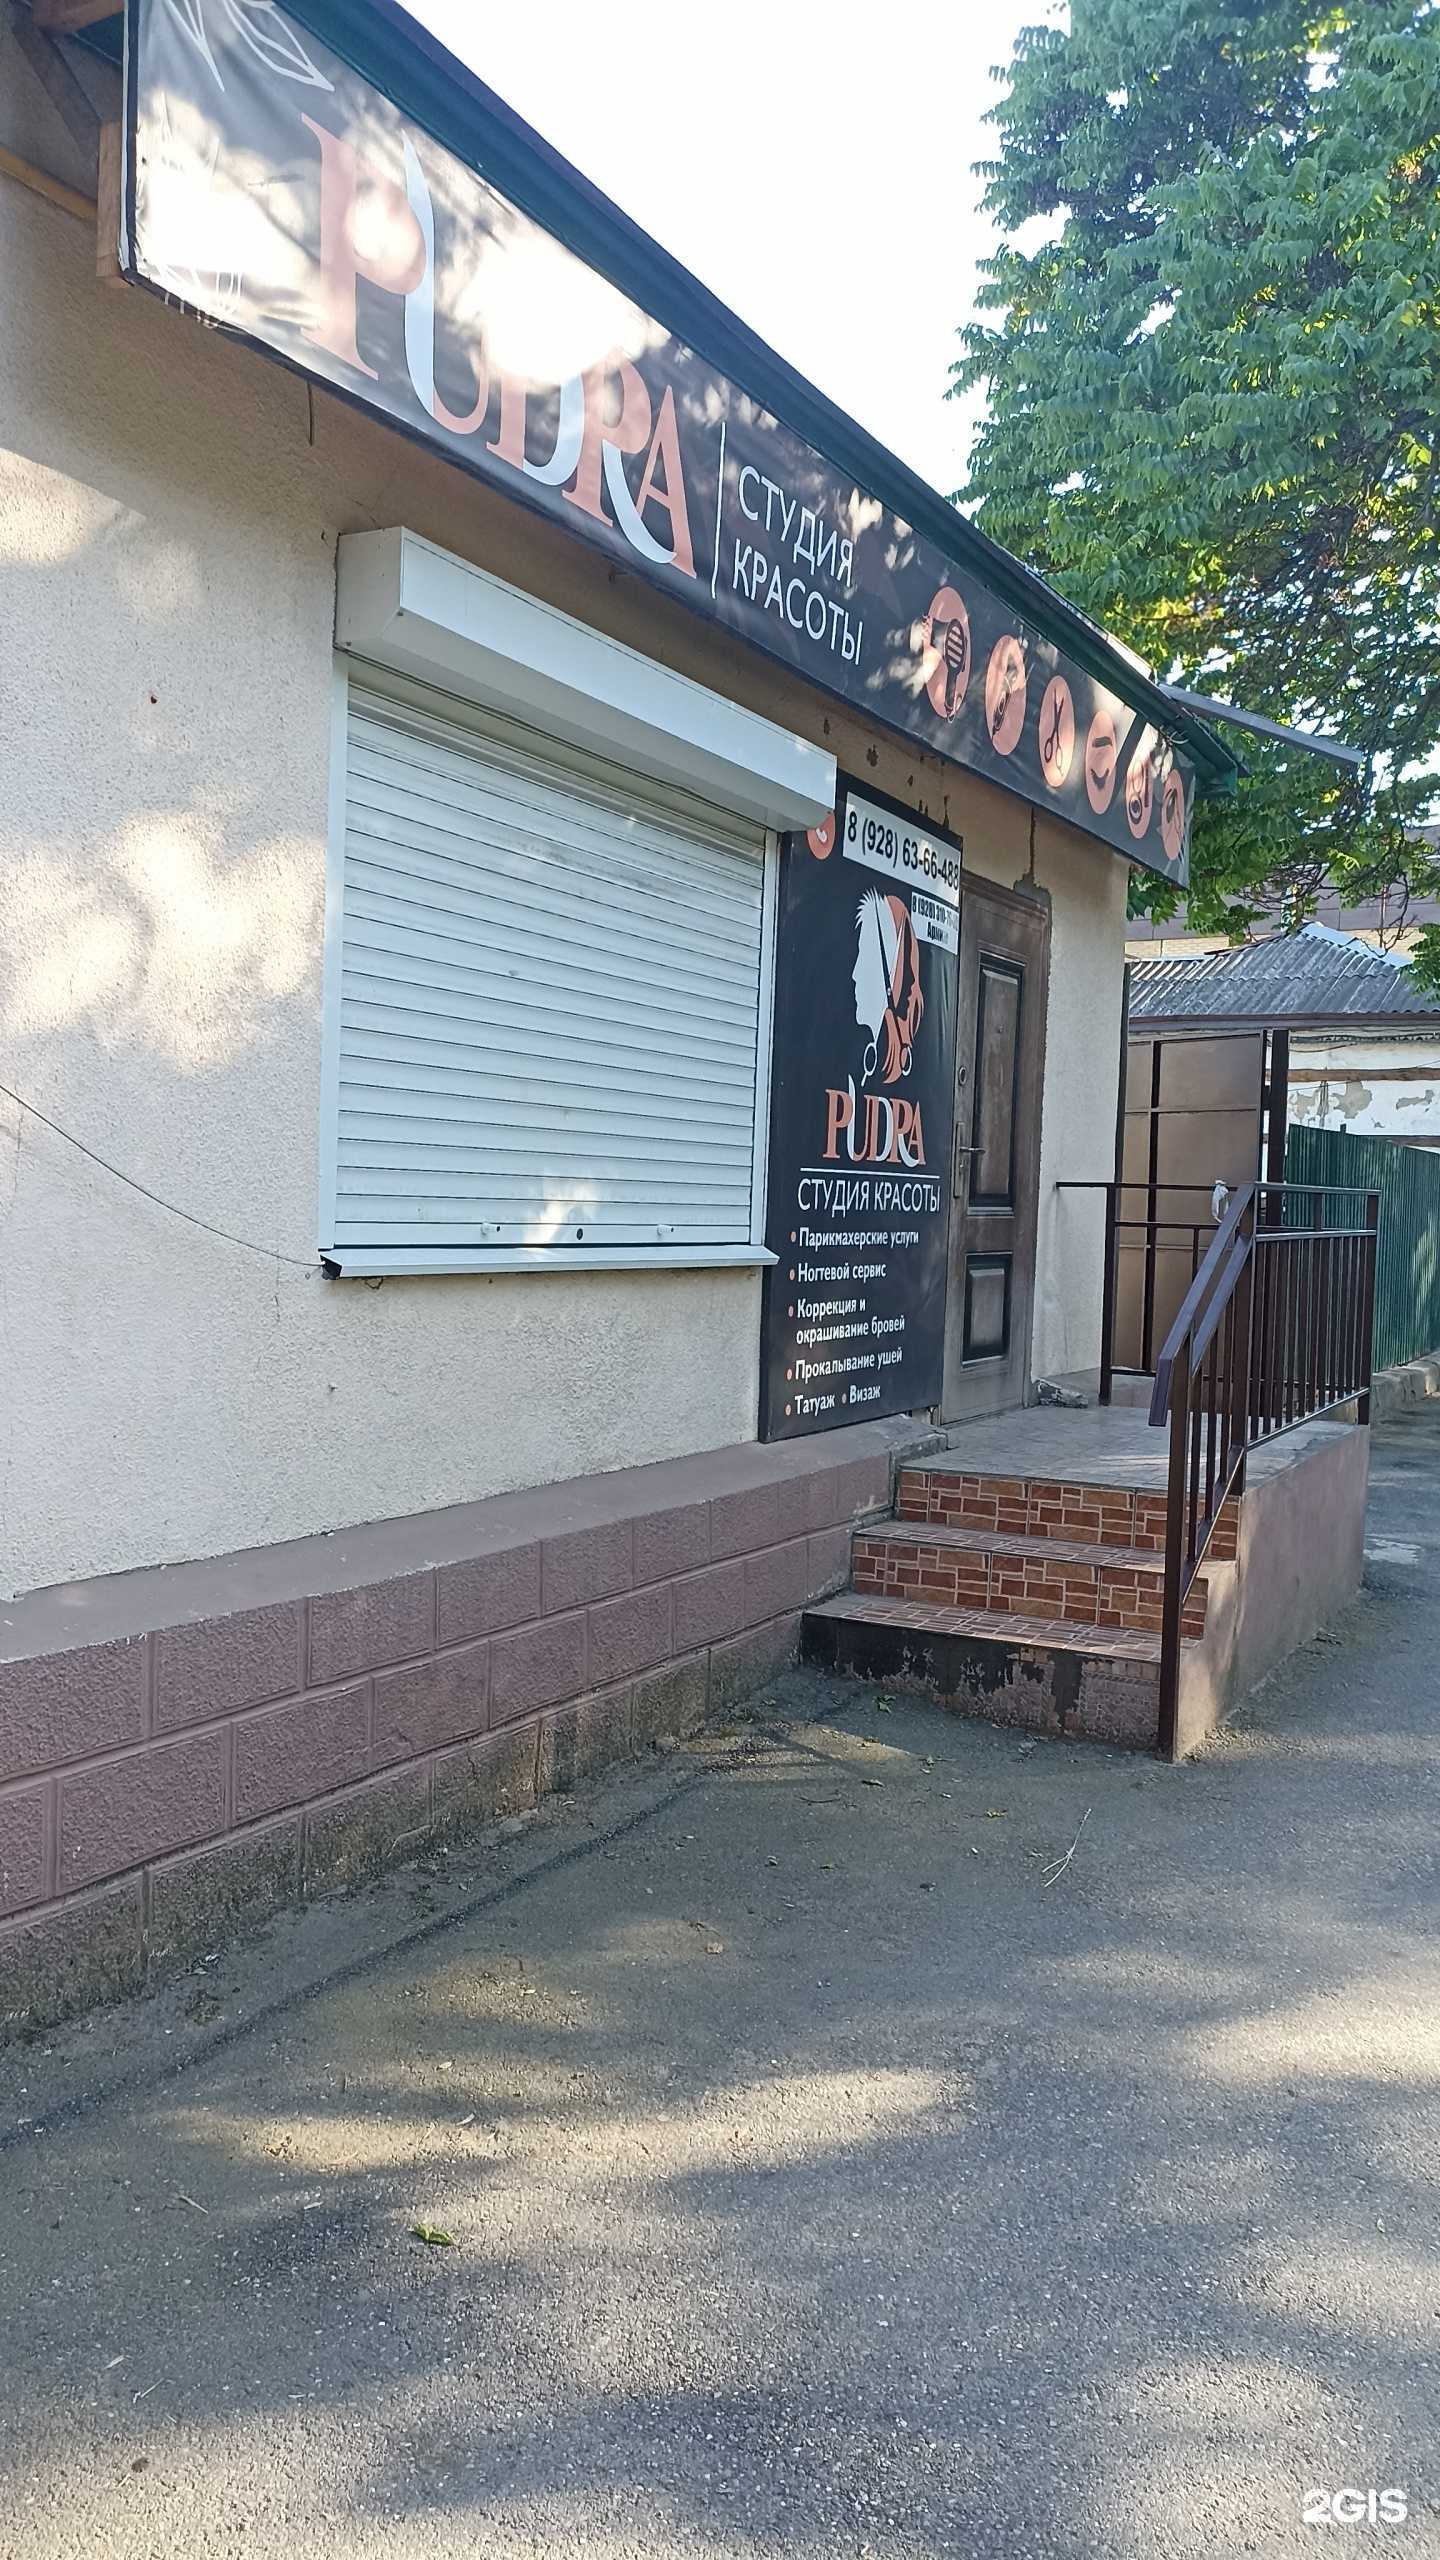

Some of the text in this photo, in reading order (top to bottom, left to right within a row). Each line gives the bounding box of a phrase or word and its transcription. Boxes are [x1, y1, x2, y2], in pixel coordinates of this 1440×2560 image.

[301, 113, 697, 579] PUDRA
[738, 466, 854, 587] СТУДИЯ
[732, 538, 863, 665] КРАСОТЫ
[848, 811, 959, 891] 8 (928) 63-66-488
[822, 1074, 926, 1167] PUDRA
[798, 1178, 940, 1218] СТУДИЯ КРАСОТЫ
[799, 1227, 919, 1251] Парикмахерские услуги
[798, 1262, 887, 1284] Ногтевой сервис
[797, 1298, 866, 1323] Коррекция и
[796, 1315, 905, 1349] окрашивание бровей
[795, 1346, 903, 1384] Прокалывание ушей
[795, 1385, 881, 1417] Татуаж Визаж
